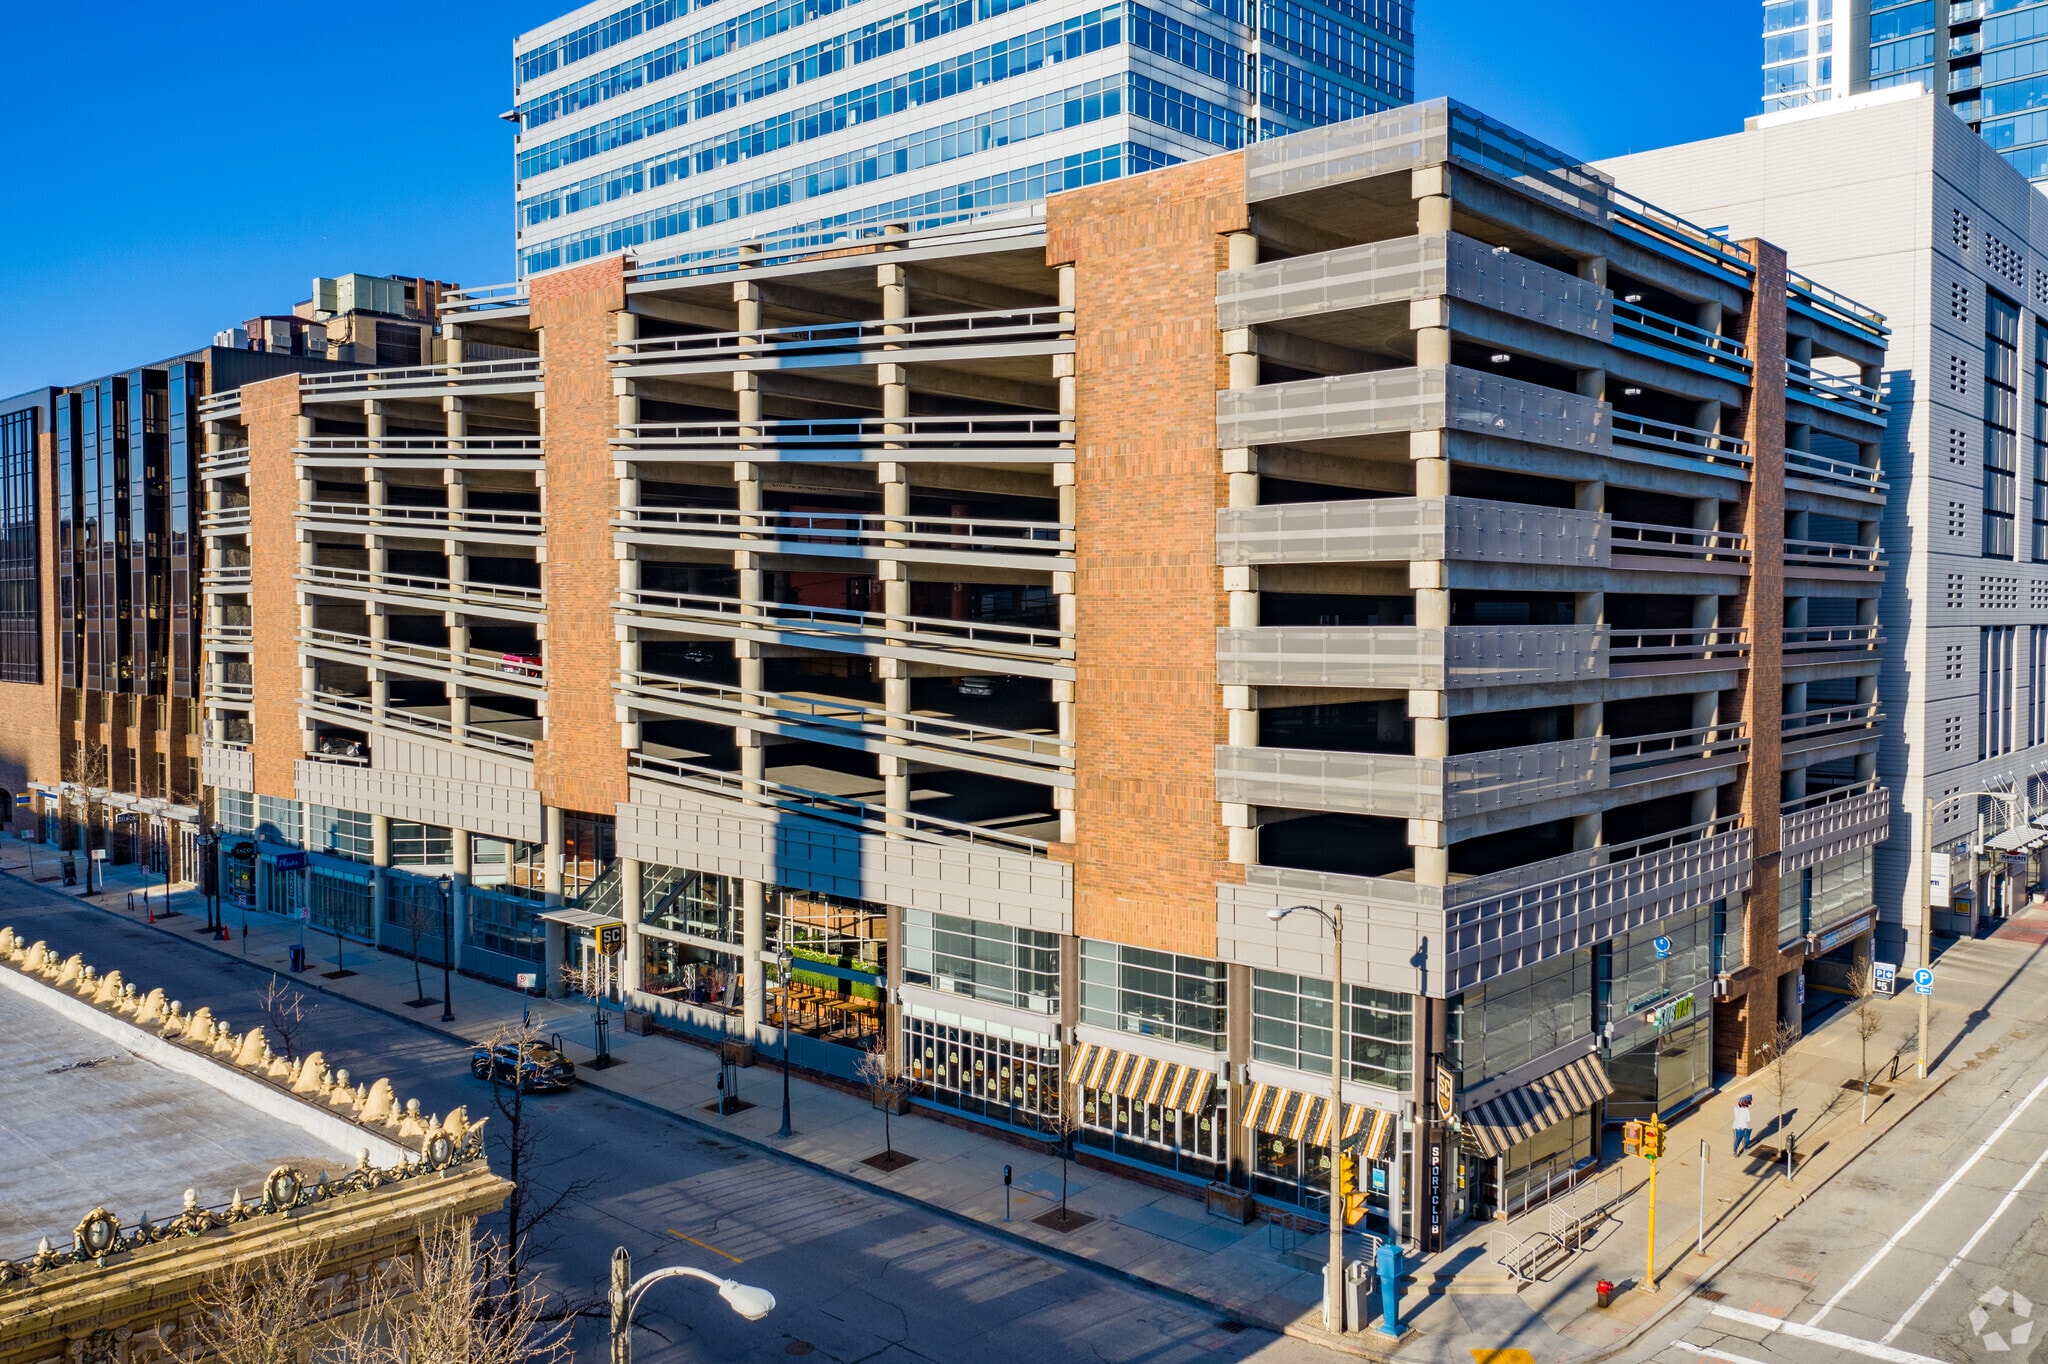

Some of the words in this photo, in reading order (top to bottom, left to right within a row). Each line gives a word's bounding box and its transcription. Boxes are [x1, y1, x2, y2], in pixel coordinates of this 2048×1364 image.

[603, 929, 620, 943] SC
[1876, 970, 1883, 979] P
[1919, 972, 1929, 984] P
[1877, 980, 1888, 991] $5
[1655, 992, 1695, 1032] SUBWAY
[1439, 1074, 1451, 1098] SC
[1432, 1146, 1440, 1234] SPORTCLUB
